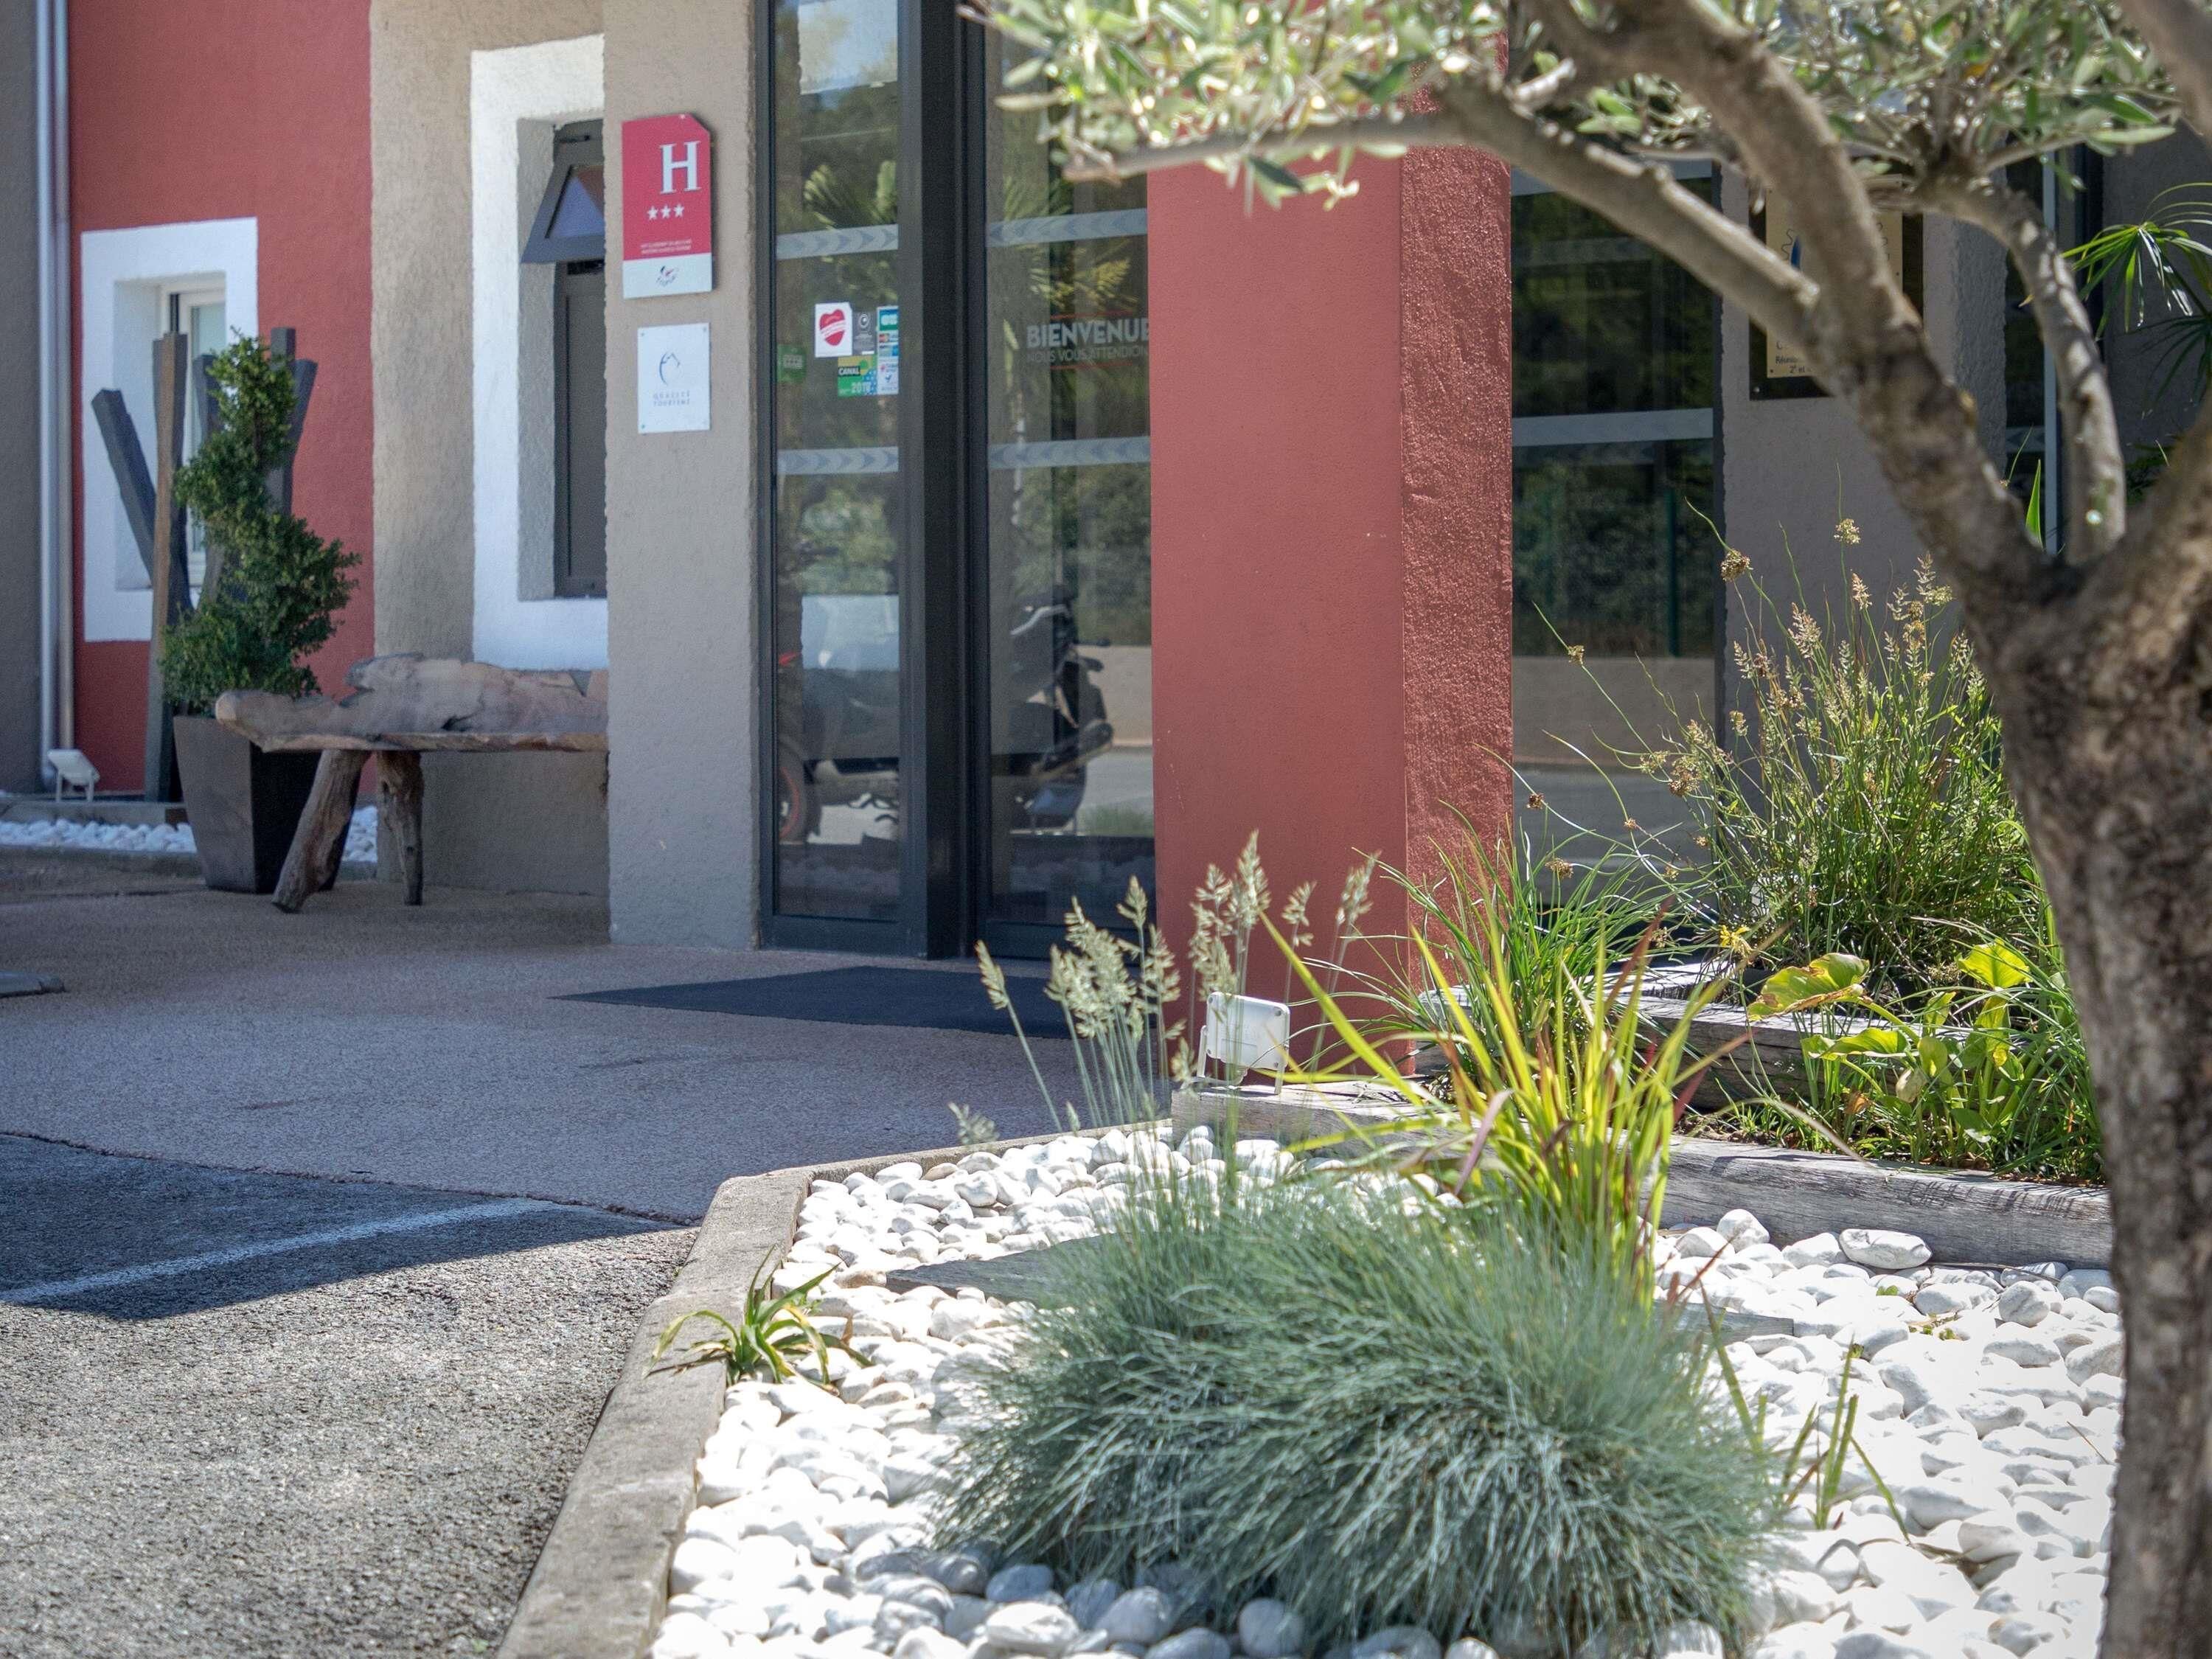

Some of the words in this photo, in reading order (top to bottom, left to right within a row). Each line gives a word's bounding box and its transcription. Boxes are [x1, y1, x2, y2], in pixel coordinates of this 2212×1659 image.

[659, 140, 701, 195] H
[1058, 348, 1088, 362] VOUS
[838, 367, 859, 375] CANAL
